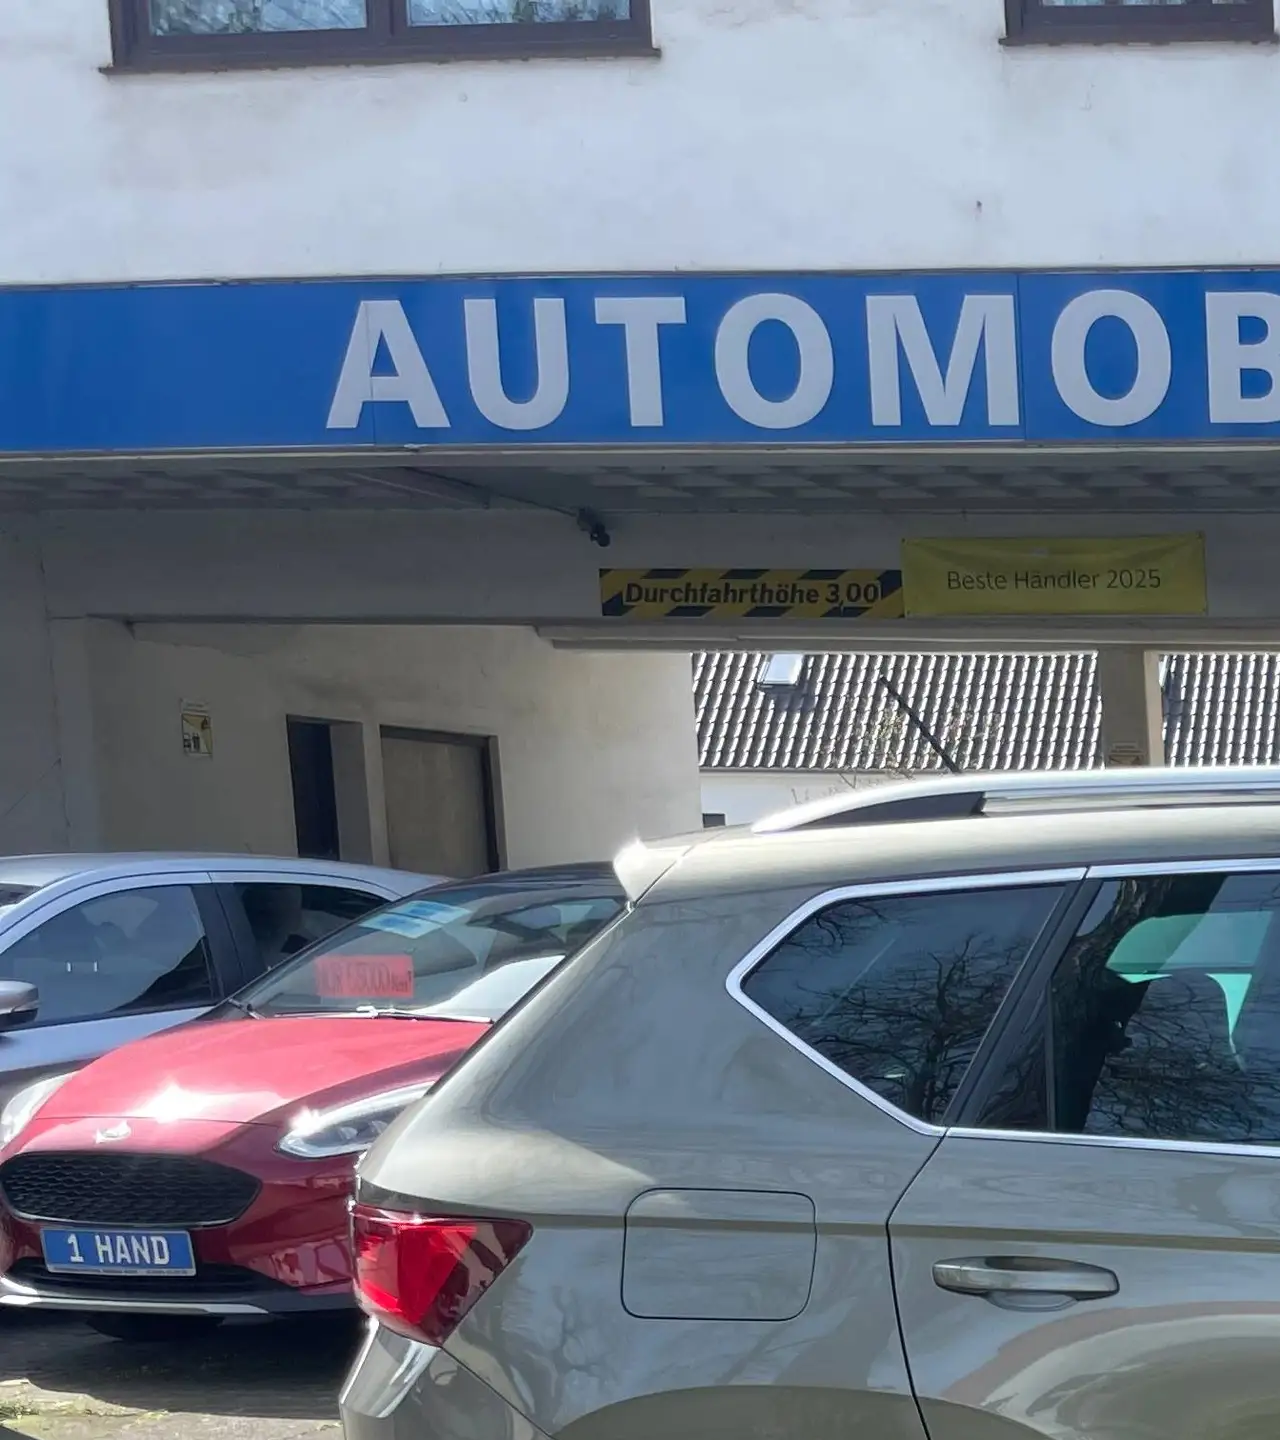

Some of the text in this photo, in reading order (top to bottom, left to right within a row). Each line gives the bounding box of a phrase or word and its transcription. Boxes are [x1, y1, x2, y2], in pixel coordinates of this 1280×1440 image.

[947, 568, 1161, 590] Beste Händler 2025
[624, 580, 878, 609] Durchfahrthöhe 3,00
[67, 1233, 170, 1265] 1 HAND
